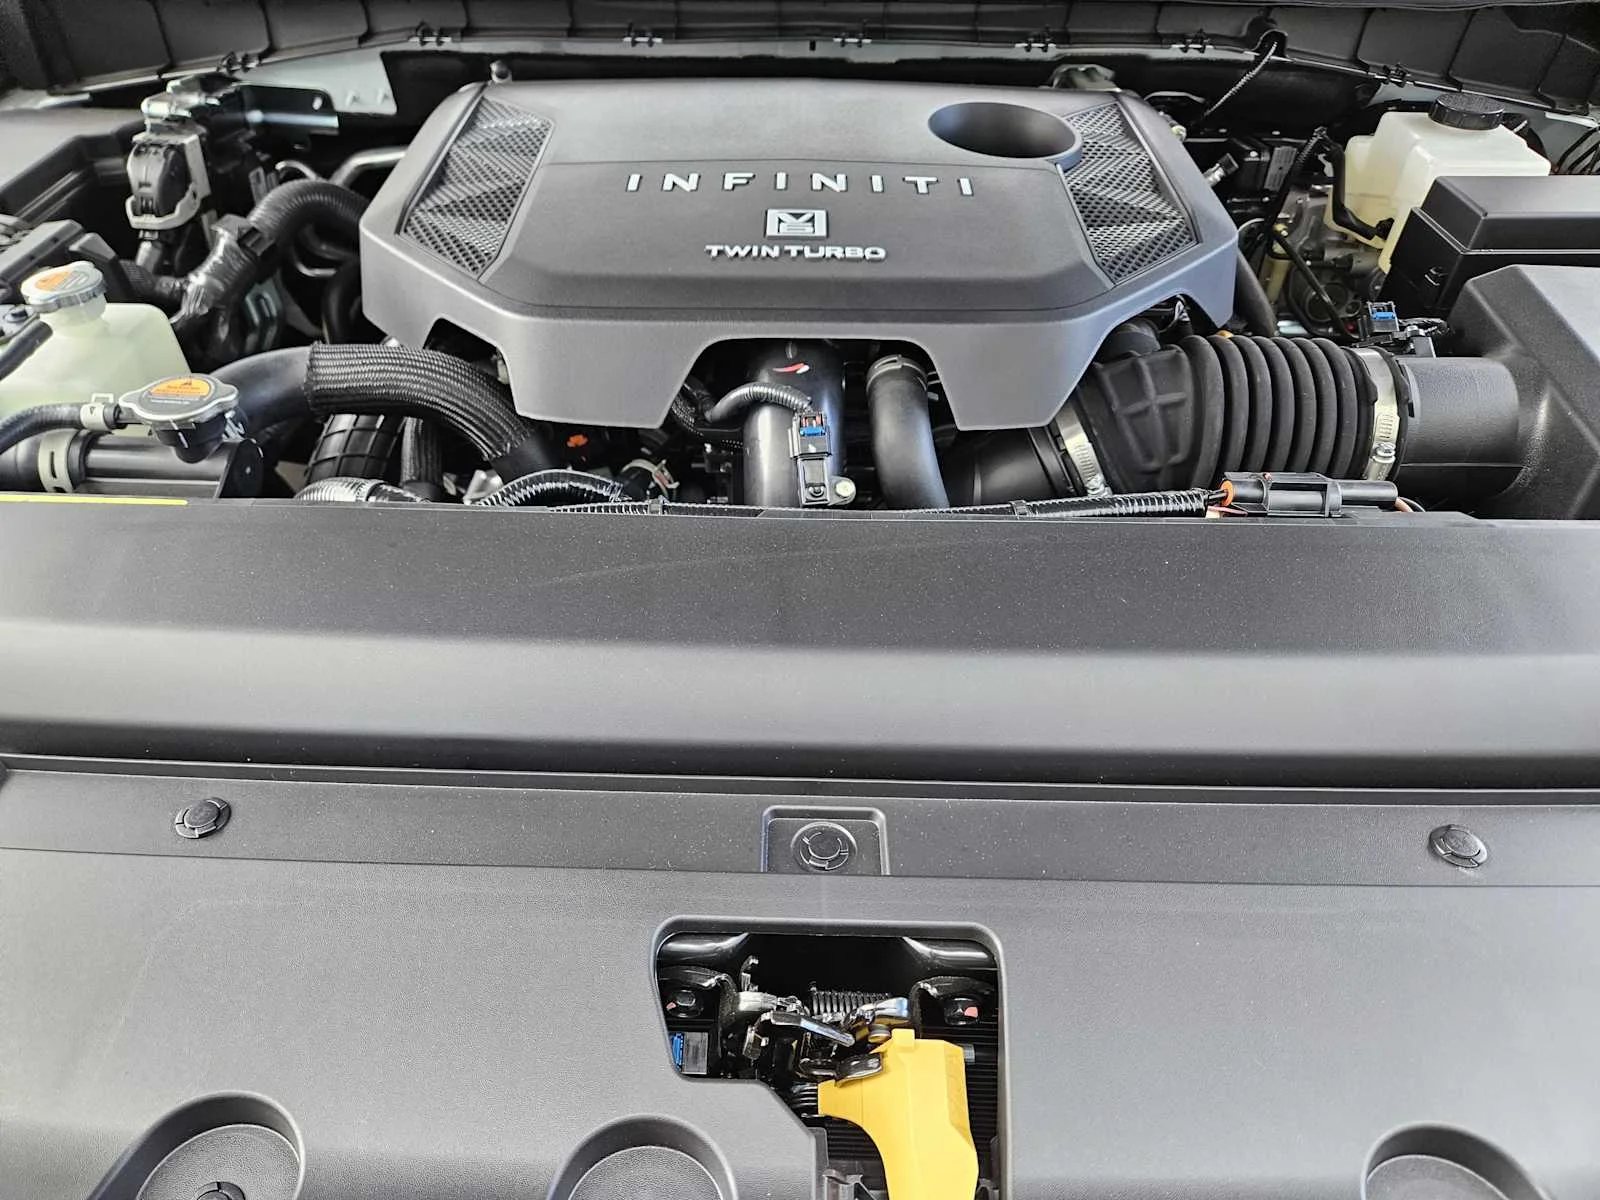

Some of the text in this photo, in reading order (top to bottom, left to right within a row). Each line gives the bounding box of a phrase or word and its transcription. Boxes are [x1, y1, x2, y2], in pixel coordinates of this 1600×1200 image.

[625, 171, 975, 196] INFINITI
[704, 244, 887, 261] TWIN TURBO
